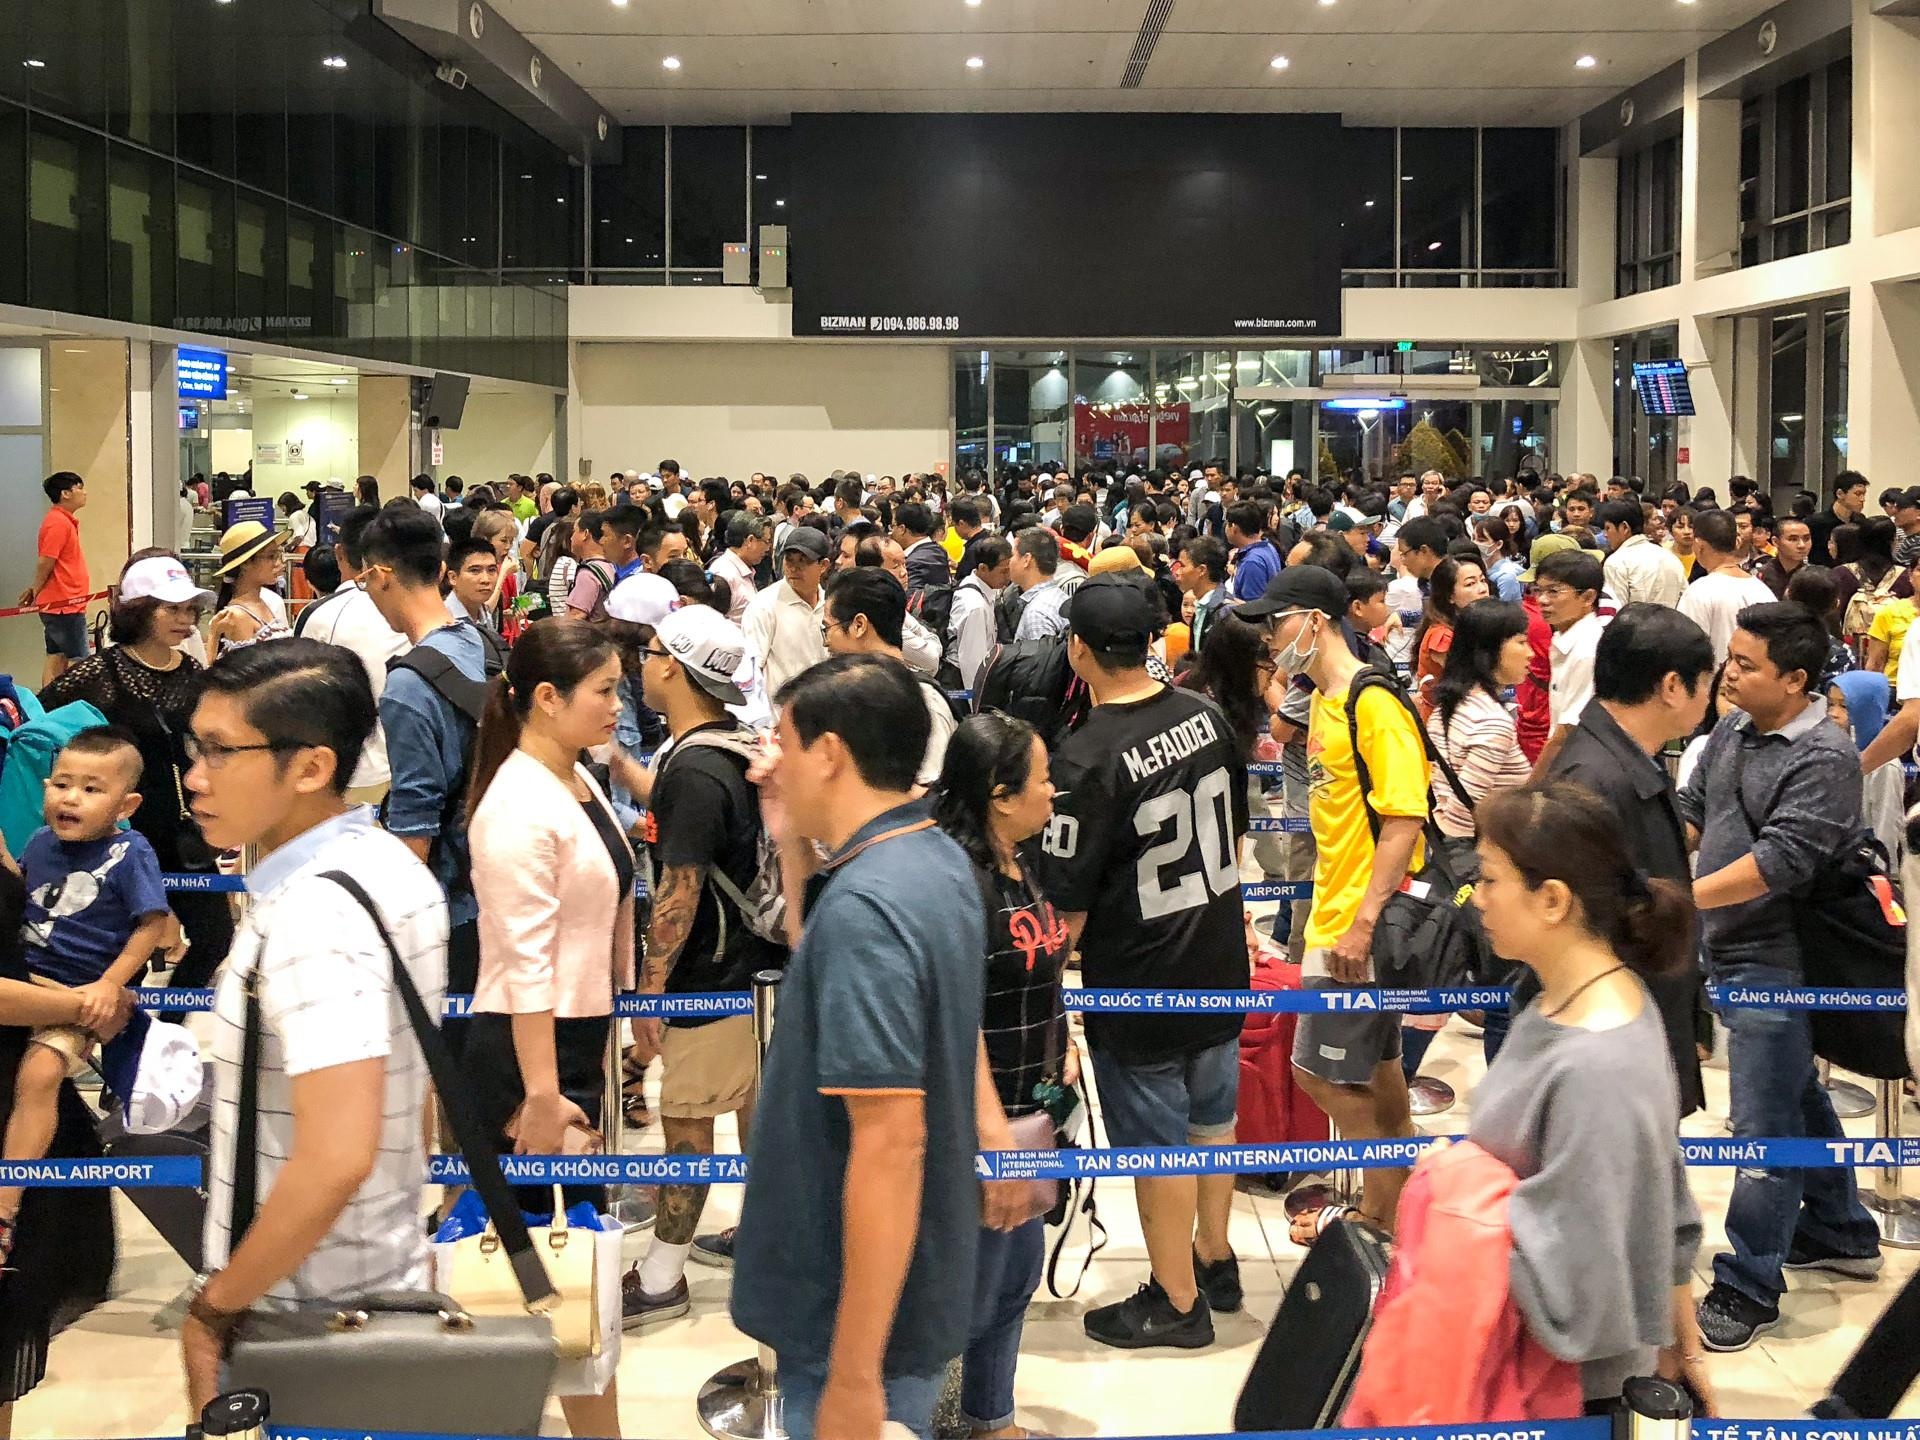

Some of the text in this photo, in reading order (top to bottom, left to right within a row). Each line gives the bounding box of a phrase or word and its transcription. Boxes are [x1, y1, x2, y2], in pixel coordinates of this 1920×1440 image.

[820, 316, 959, 330] BIZMAN 094.986.98.98
[1234, 318, 1317, 328] www.bizman.com.vn
[1133, 766, 1240, 920] 20
[1245, 885, 1296, 897] AIRPORT
[1099, 991, 1141, 1007] QUỐC
[1145, 992, 1163, 1007] TẾ
[1167, 993, 1196, 1008] TÂN
[1200, 995, 1232, 1008] SƠN
[1235, 993, 1275, 1008] NHẤT
[1320, 992, 1376, 1010] TIA
[1440, 993, 1466, 1005] TAN
[1471, 992, 1500, 1004] SON
[1728, 988, 1770, 1003] CẢNG
[1774, 990, 1816, 1005] HÀNG
[1819, 991, 1871, 1006] KHÔNG
[619, 1000, 657, 1012] NHAT
[1075, 1155, 1111, 1171] TAN
[1116, 1154, 1155, 1170] SON
[1160, 1152, 1210, 1169] NHAT
[1214, 1146, 1359, 1167] INTERNATIONAL
[1718, 1141, 1767, 1160] NHẤT
[1826, 1142, 1895, 1163] TIA
[70, 1164, 154, 1180] AIRPORT
[550, 1158, 620, 1177] KHÔNG
[626, 1157, 681, 1177] QUỐC
[686, 1157, 711, 1177] TẾ
[1001, 1160, 1064, 1169] INTERNATIONAL
[1001, 1169, 1038, 1178] AIRPORT
